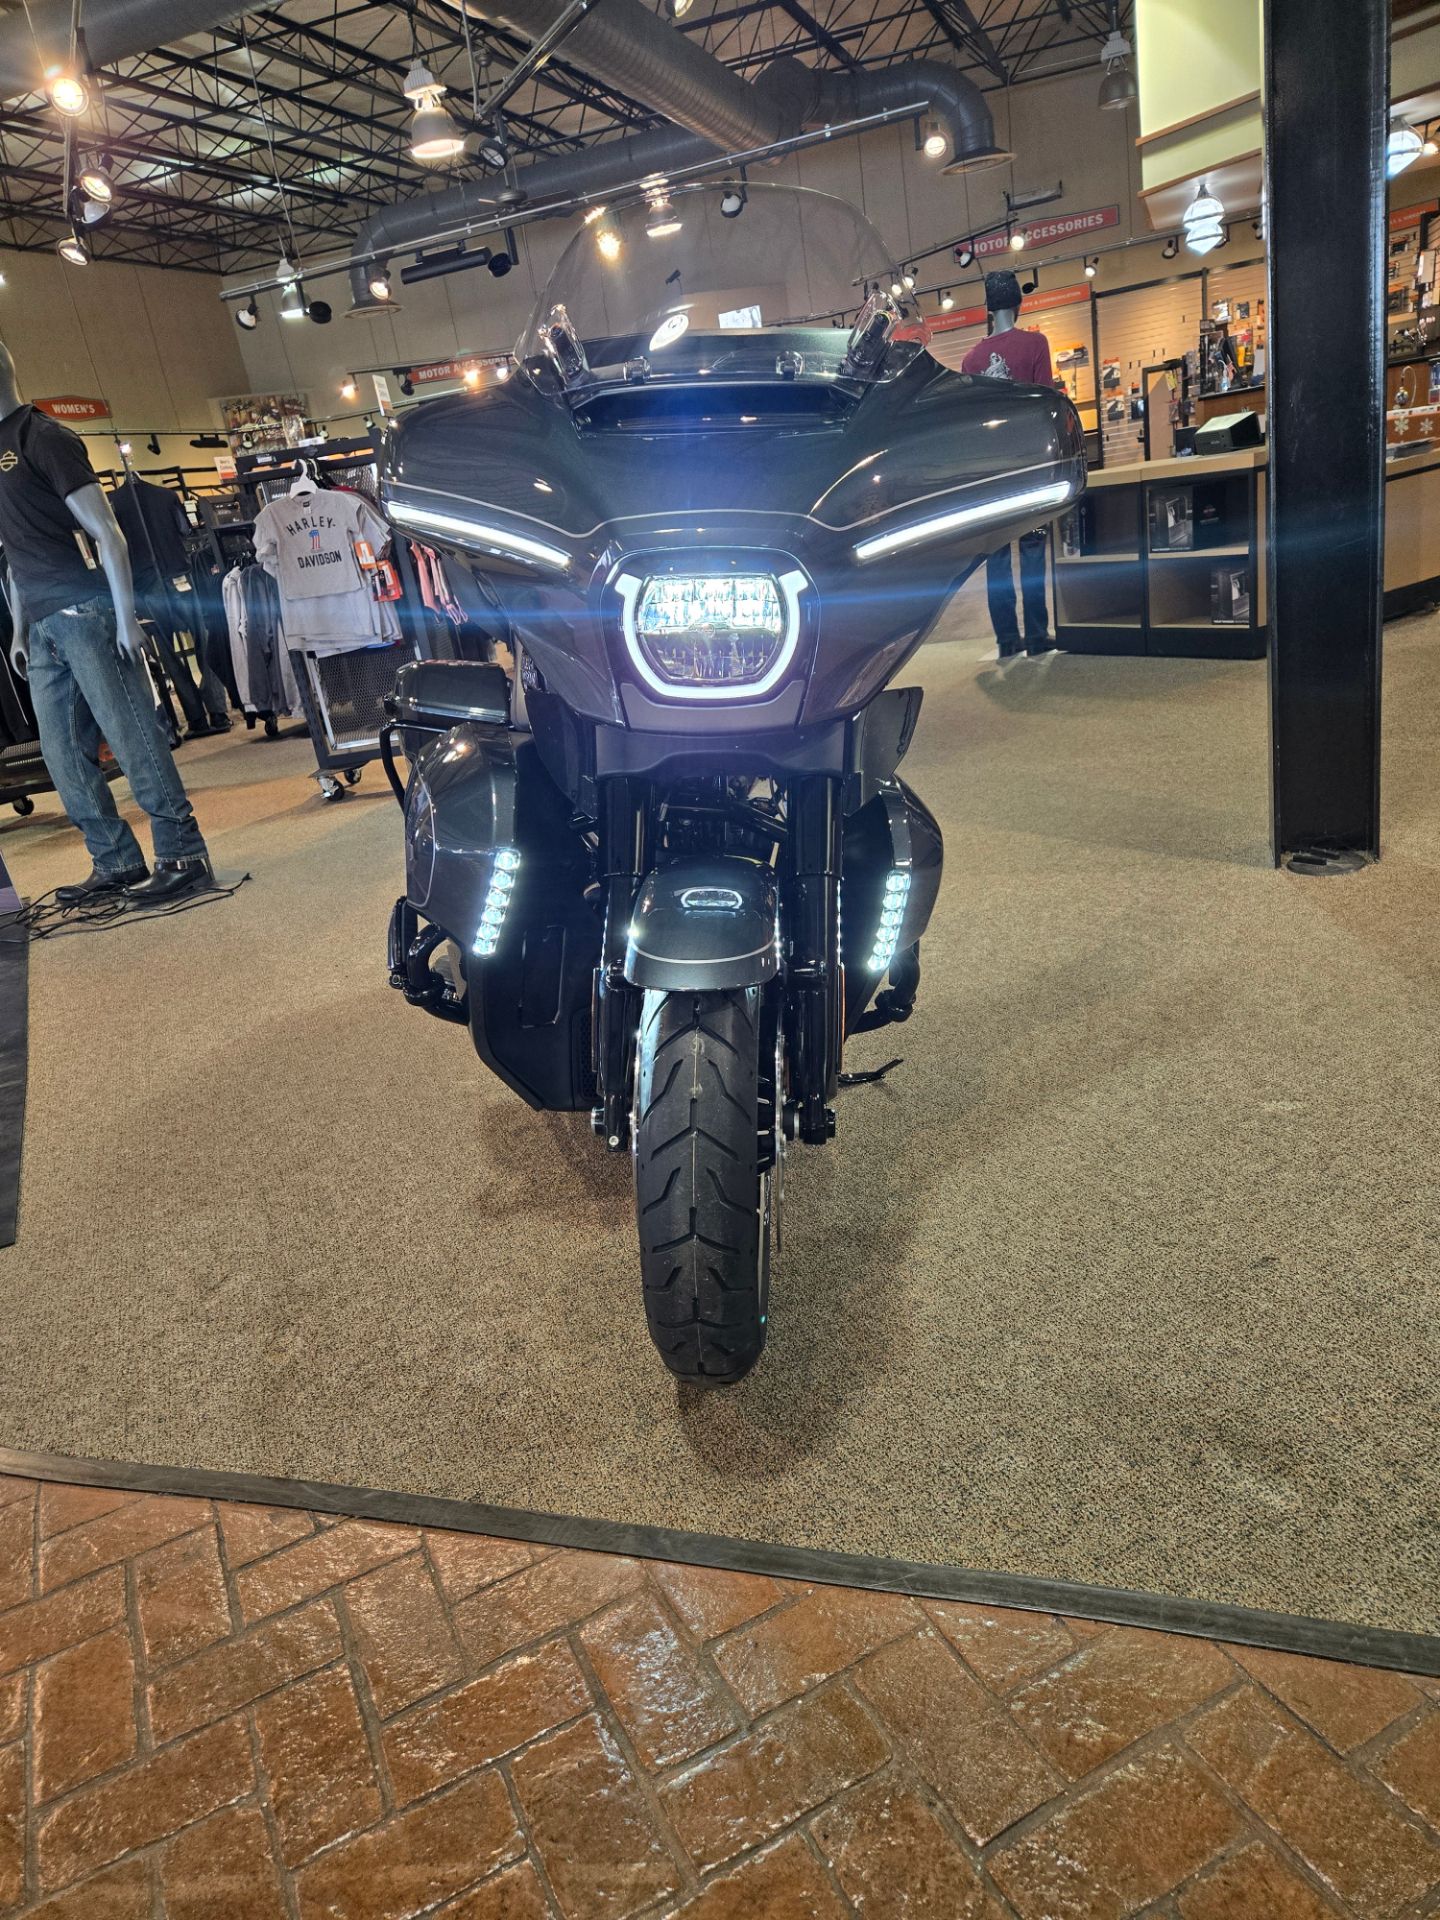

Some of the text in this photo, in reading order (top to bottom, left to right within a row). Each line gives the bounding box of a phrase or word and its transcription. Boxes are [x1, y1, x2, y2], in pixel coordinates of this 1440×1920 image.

[1019, 213, 1104, 242] CCESSORIES
[418, 366, 451, 380] MOTOR
[51, 403, 96, 414] WOMEN'S
[297, 550, 342, 569] DAVIDSON
